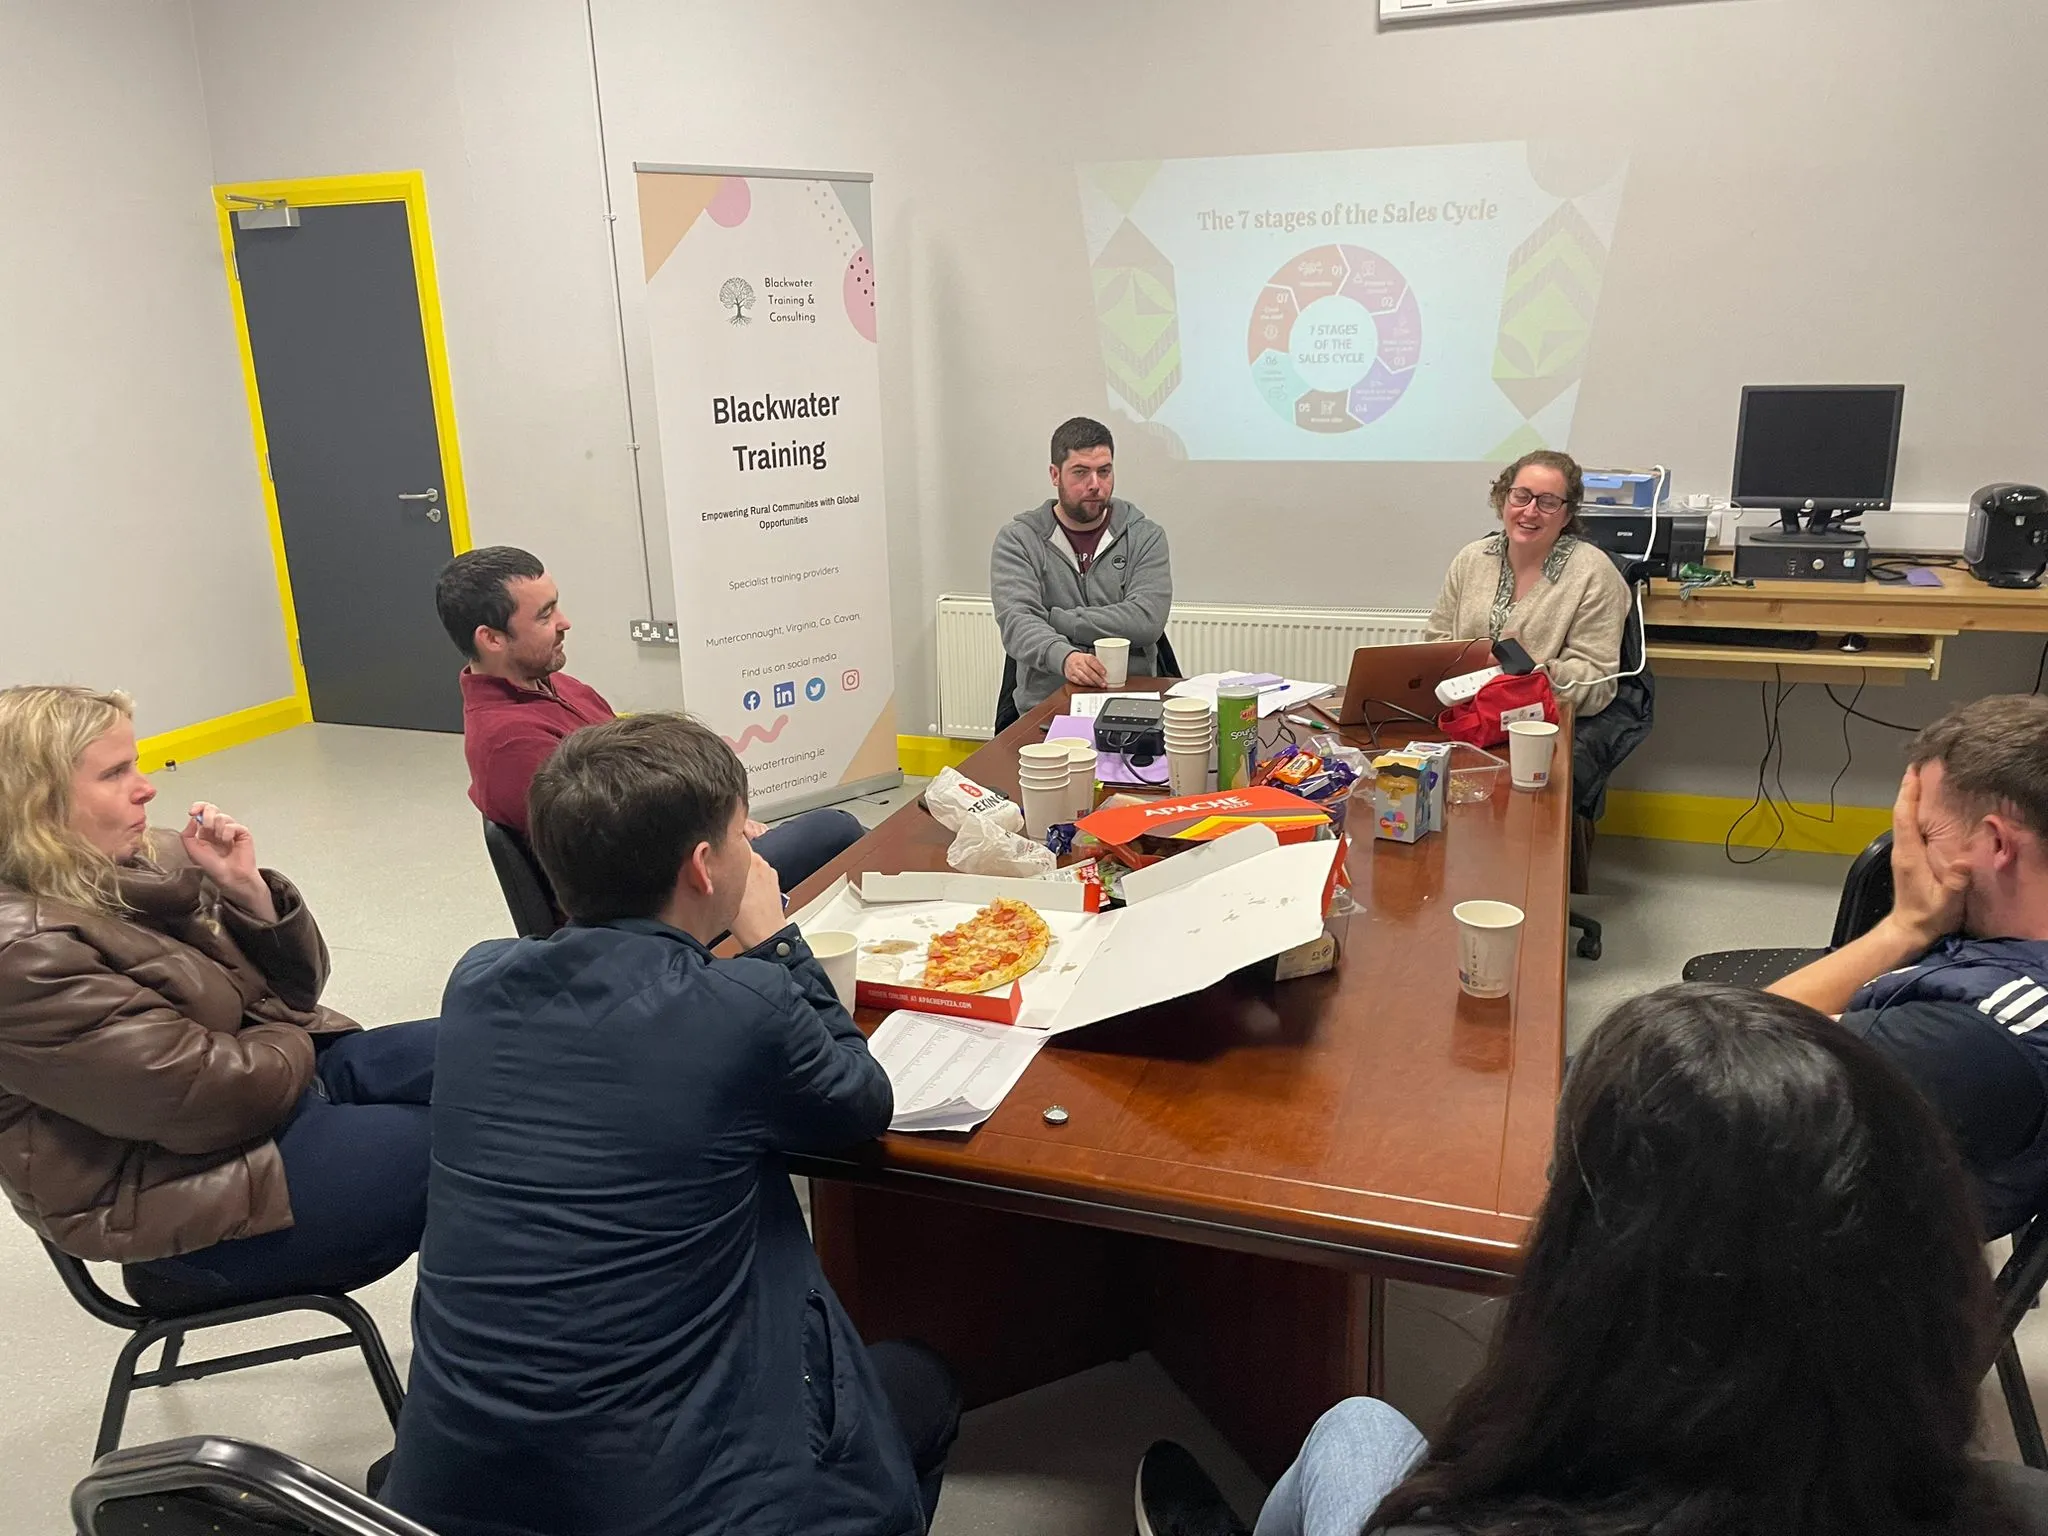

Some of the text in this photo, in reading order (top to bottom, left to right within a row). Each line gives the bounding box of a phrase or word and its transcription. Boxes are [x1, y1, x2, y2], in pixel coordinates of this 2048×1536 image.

[1197, 199, 1498, 233] The 7 stages of the Sales Cycle
[1331, 265, 1343, 276] 01
[764, 276, 813, 288] Blackwater
[768, 294, 815, 307] Training &
[1381, 296, 1394, 307] 02
[769, 311, 816, 324] Consulting
[1317, 324, 1358, 335] STAGES
[1314, 339, 1352, 349] OF THE
[1298, 353, 1365, 364] SALES CYCLE
[712, 392, 840, 425] Blackwater
[732, 440, 827, 472] Training
[701, 494, 860, 522] Empowering Rural Communities with Global
[759, 515, 809, 530] Opportunities
[728, 566, 840, 591] Specialist training providers
[705, 626, 785, 647] Munterconnaught,
[786, 620, 819, 634] Virginia,
[833, 613, 860, 624] Cavan
[741, 652, 837, 678] Find us on social media
[1144, 796, 1241, 817] APACHE
[918, 996, 973, 1010] APACHEPIZZA.COM
